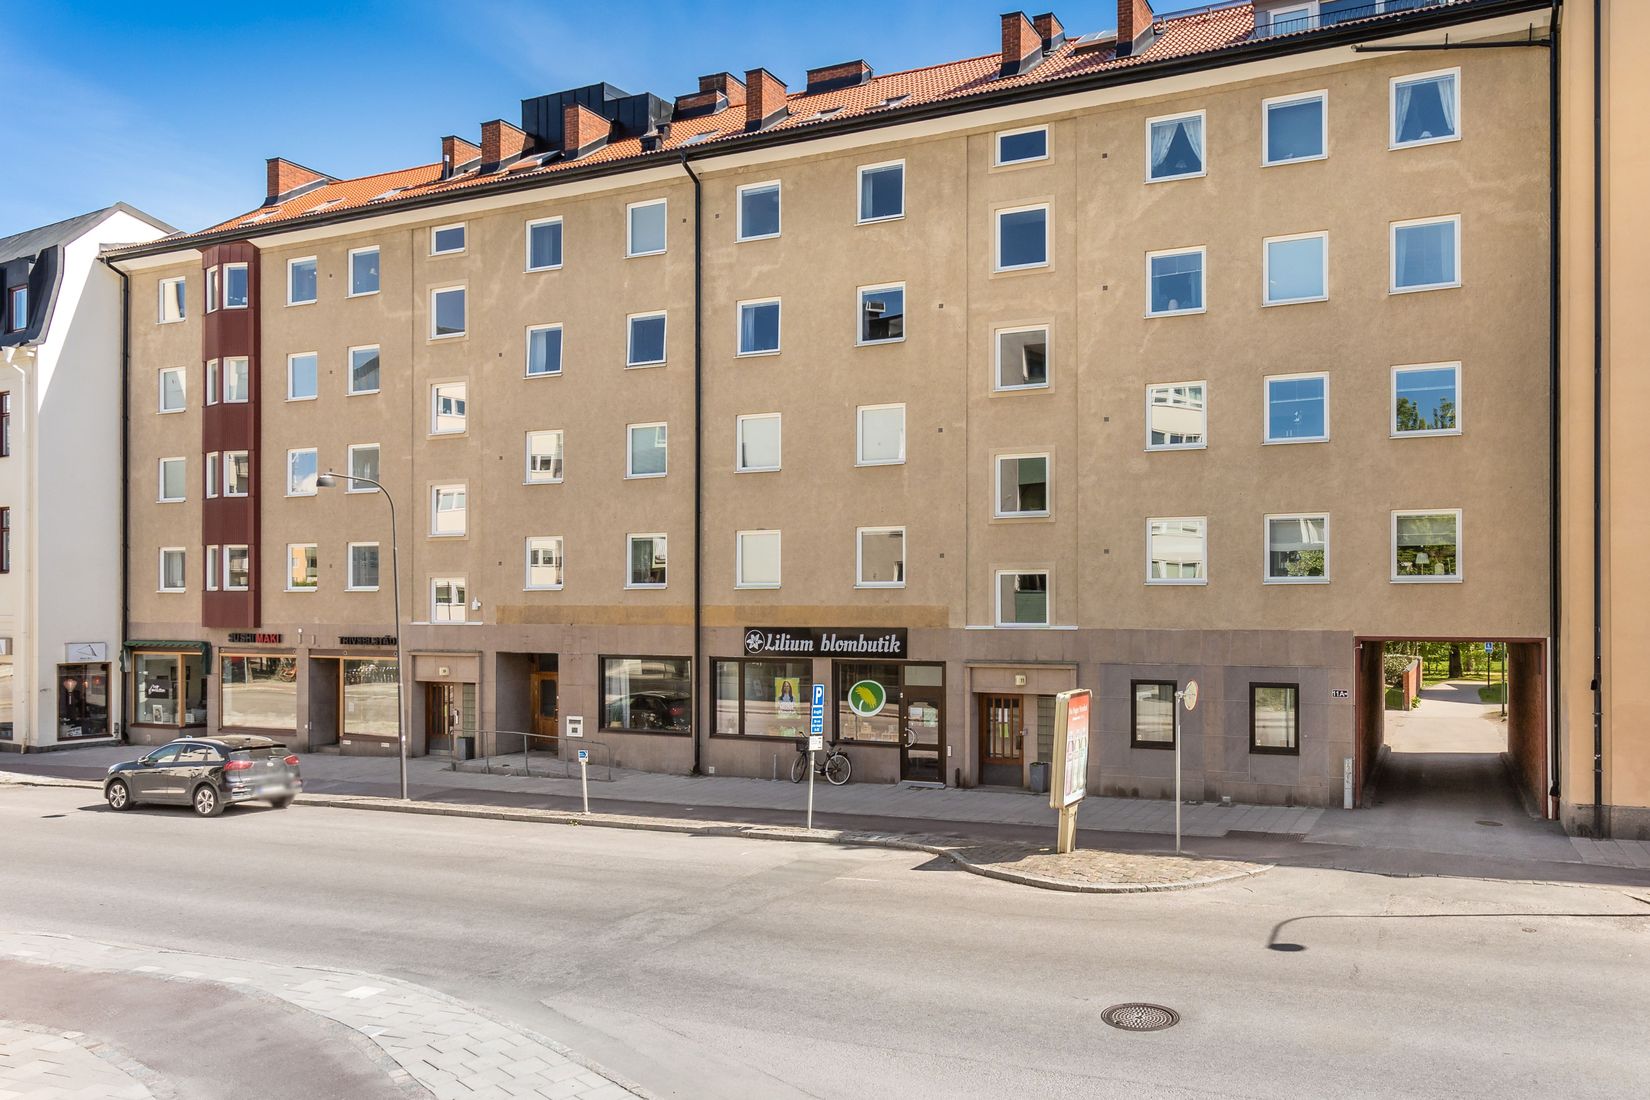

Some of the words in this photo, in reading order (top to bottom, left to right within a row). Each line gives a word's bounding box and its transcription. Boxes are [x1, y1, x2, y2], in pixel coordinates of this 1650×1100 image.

[256, 633, 281, 644] MAKI
[765, 633, 814, 651] Lilium
[820, 633, 901, 653] blombutik
[815, 686, 823, 704] P
